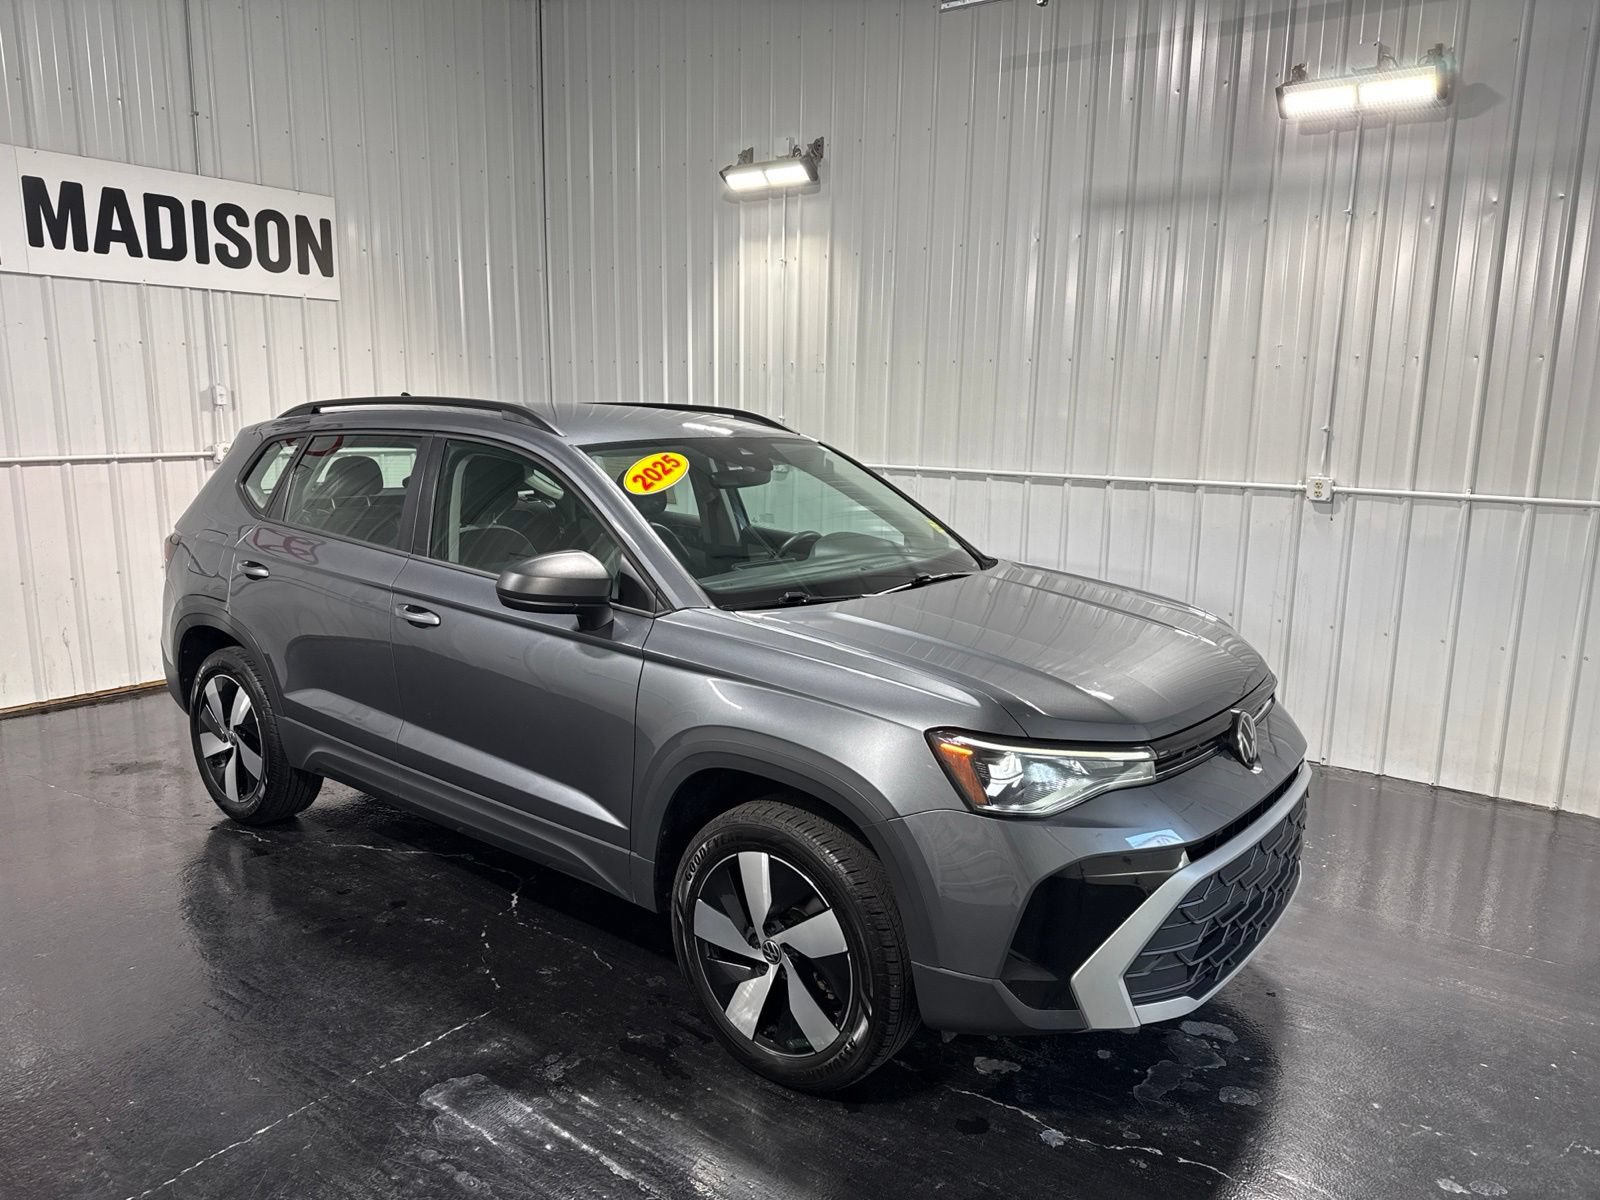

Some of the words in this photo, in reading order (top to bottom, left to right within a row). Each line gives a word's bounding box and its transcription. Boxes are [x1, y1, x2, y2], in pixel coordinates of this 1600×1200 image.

[21, 175, 335, 278] MADISON
[632, 454, 681, 491] 2025
[685, 831, 744, 882] GOODYEAR
